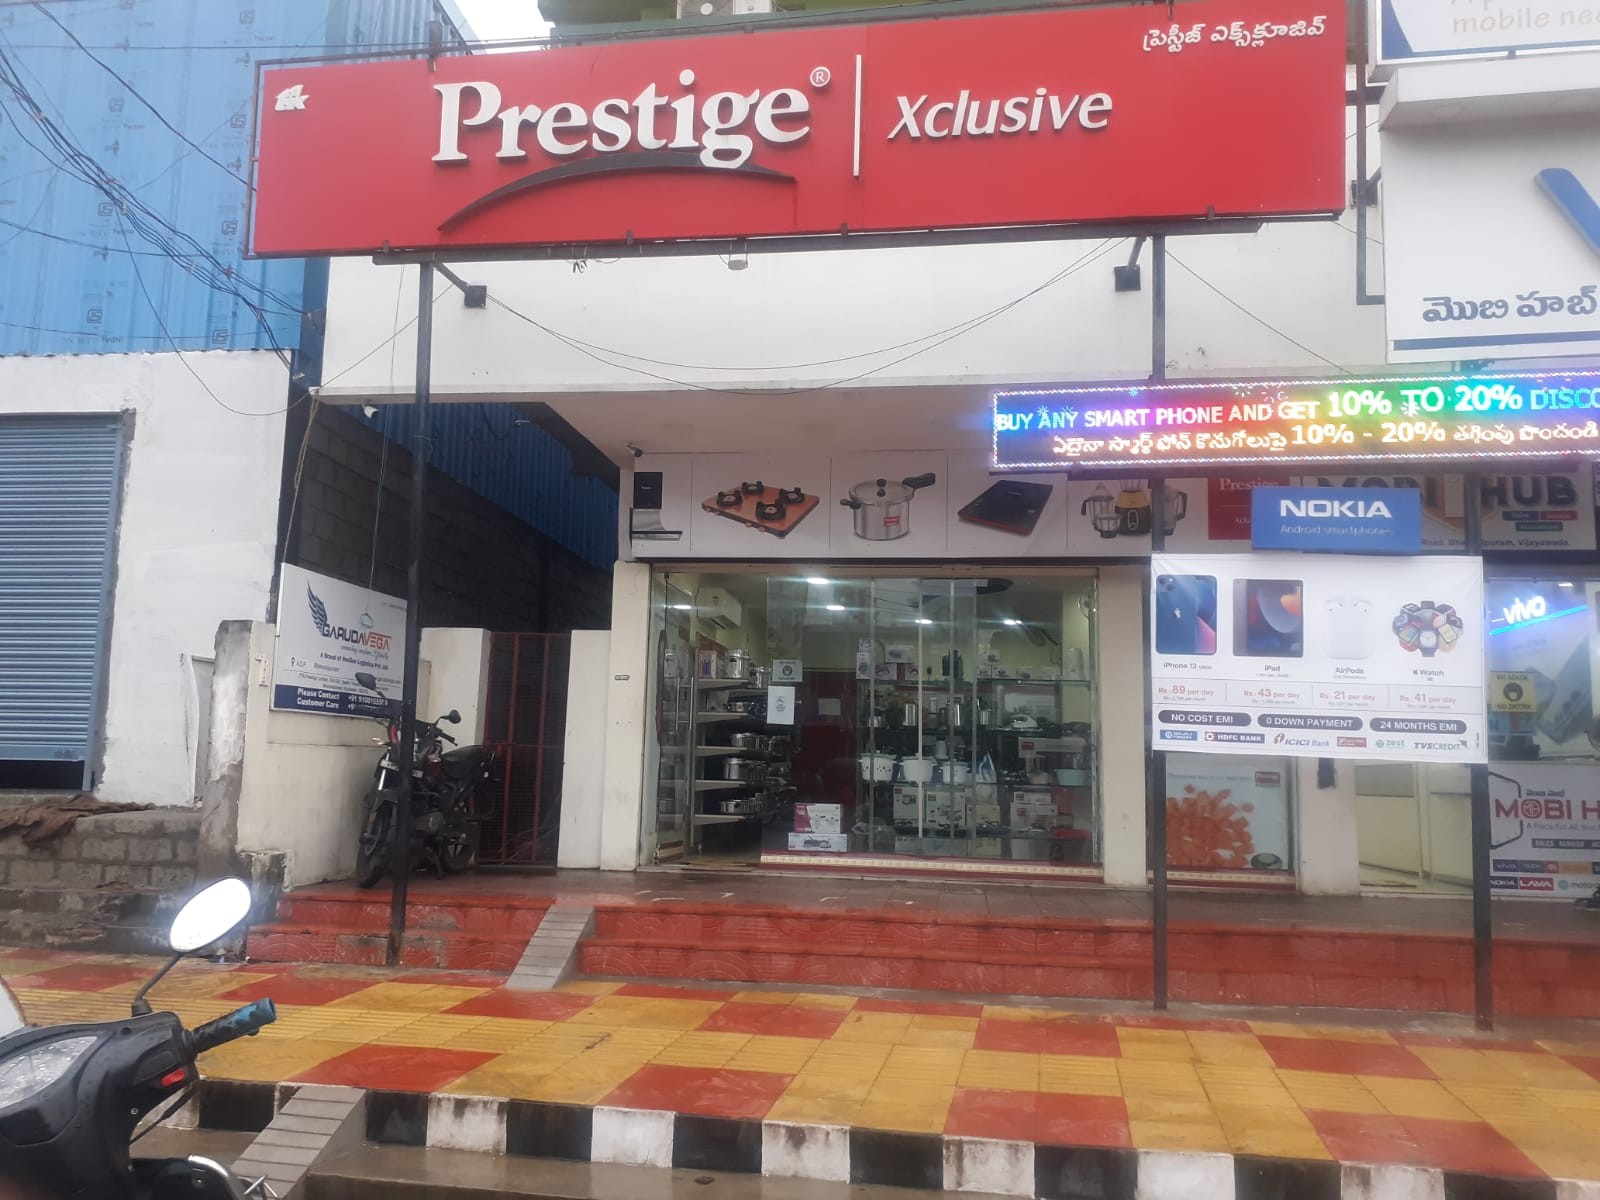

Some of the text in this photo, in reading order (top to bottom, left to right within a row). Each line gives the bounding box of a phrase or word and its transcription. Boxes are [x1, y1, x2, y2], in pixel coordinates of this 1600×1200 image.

[1453, 8, 1550, 33] mobile
[1143, 24, 1206, 52] ప్రెస్టీజ్
[432, 69, 1113, 169] Prestige Xclusive
[1422, 296, 1509, 322] మొబి
[998, 384, 1600, 430] BUY ANY SMART PHONE AND GET 10% TO 20% DISCO
[1291, 423, 1354, 445] 10%
[1380, 421, 1446, 443] 20%
[1480, 475, 1577, 506] HUB
[1279, 499, 1393, 518] NOKIA
[1280, 524, 1321, 536] Android
[1503, 595, 1546, 625] vivo
[321, 622, 392, 651] GARUDAVEGA
[1163, 662, 1188, 670] iPhone
[1264, 664, 1281, 672] iPad
[1335, 665, 1365, 674] AirPods
[1419, 669, 1444, 677] Watch
[297, 688, 317, 698] Please
[319, 690, 340, 700] Contact
[1172, 685, 1186, 694] 89
[1201, 688, 1214, 697] day
[1258, 688, 1272, 697] 43
[1287, 691, 1301, 699] day
[1334, 691, 1345, 700] 21
[297, 698, 325, 707] Customer
[326, 700, 339, 709] Care
[1171, 713, 1233, 723] NO COST EMI
[1274, 717, 1304, 726] DOWN
[1307, 718, 1353, 728] PAYMENT
[1380, 721, 1457, 732] 24 MONTHS EMI
[1285, 738, 1310, 746] ICICI
[1495, 797, 1573, 820] MOBI
[1519, 880, 1553, 888] LAVA
